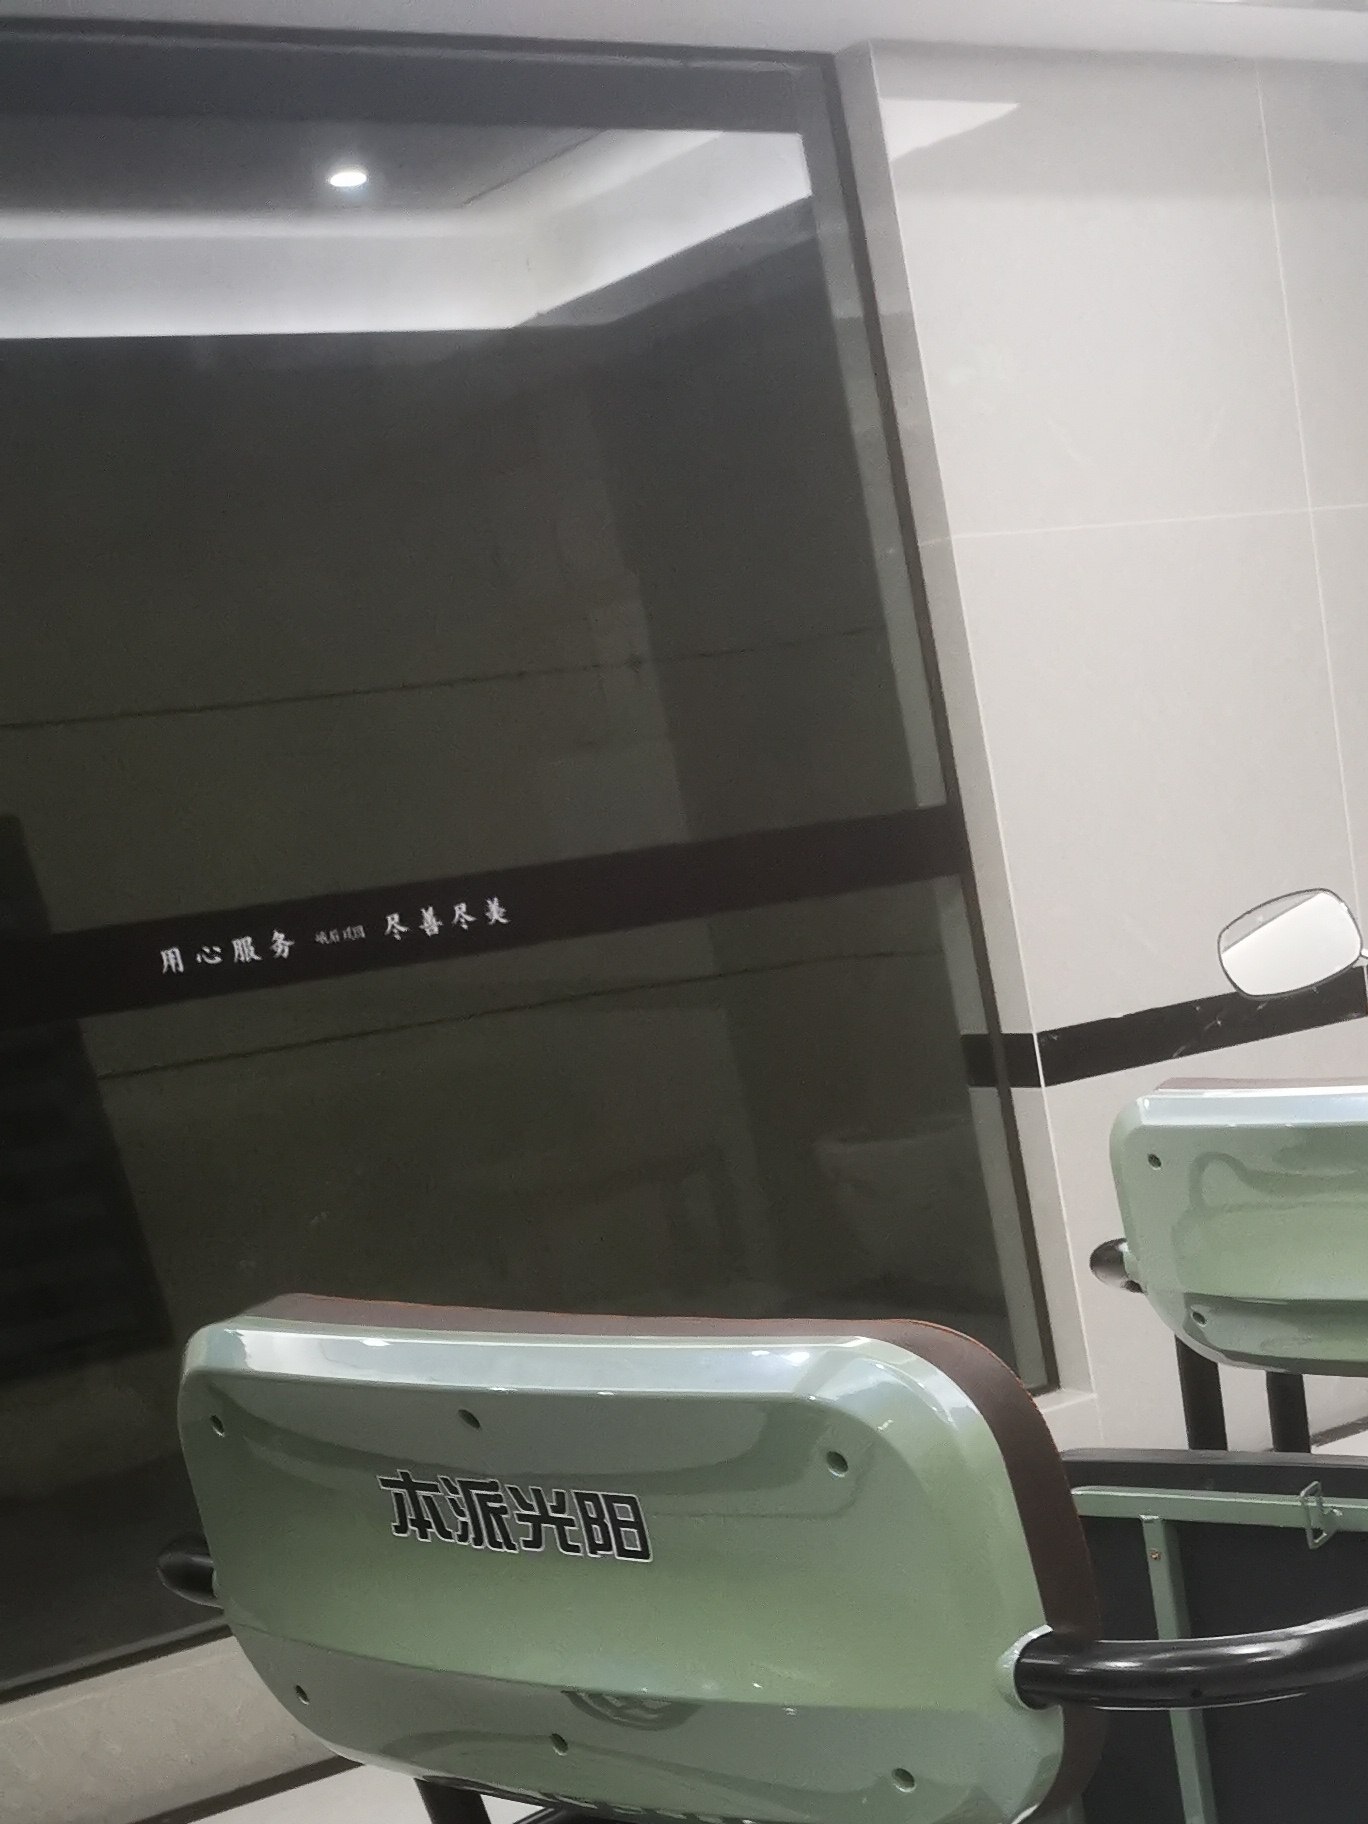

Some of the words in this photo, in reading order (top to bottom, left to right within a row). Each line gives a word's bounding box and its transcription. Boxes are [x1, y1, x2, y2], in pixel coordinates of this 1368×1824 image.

[384, 897, 509, 941] 尽善尽美
[161, 930, 295, 974] 用心服务
